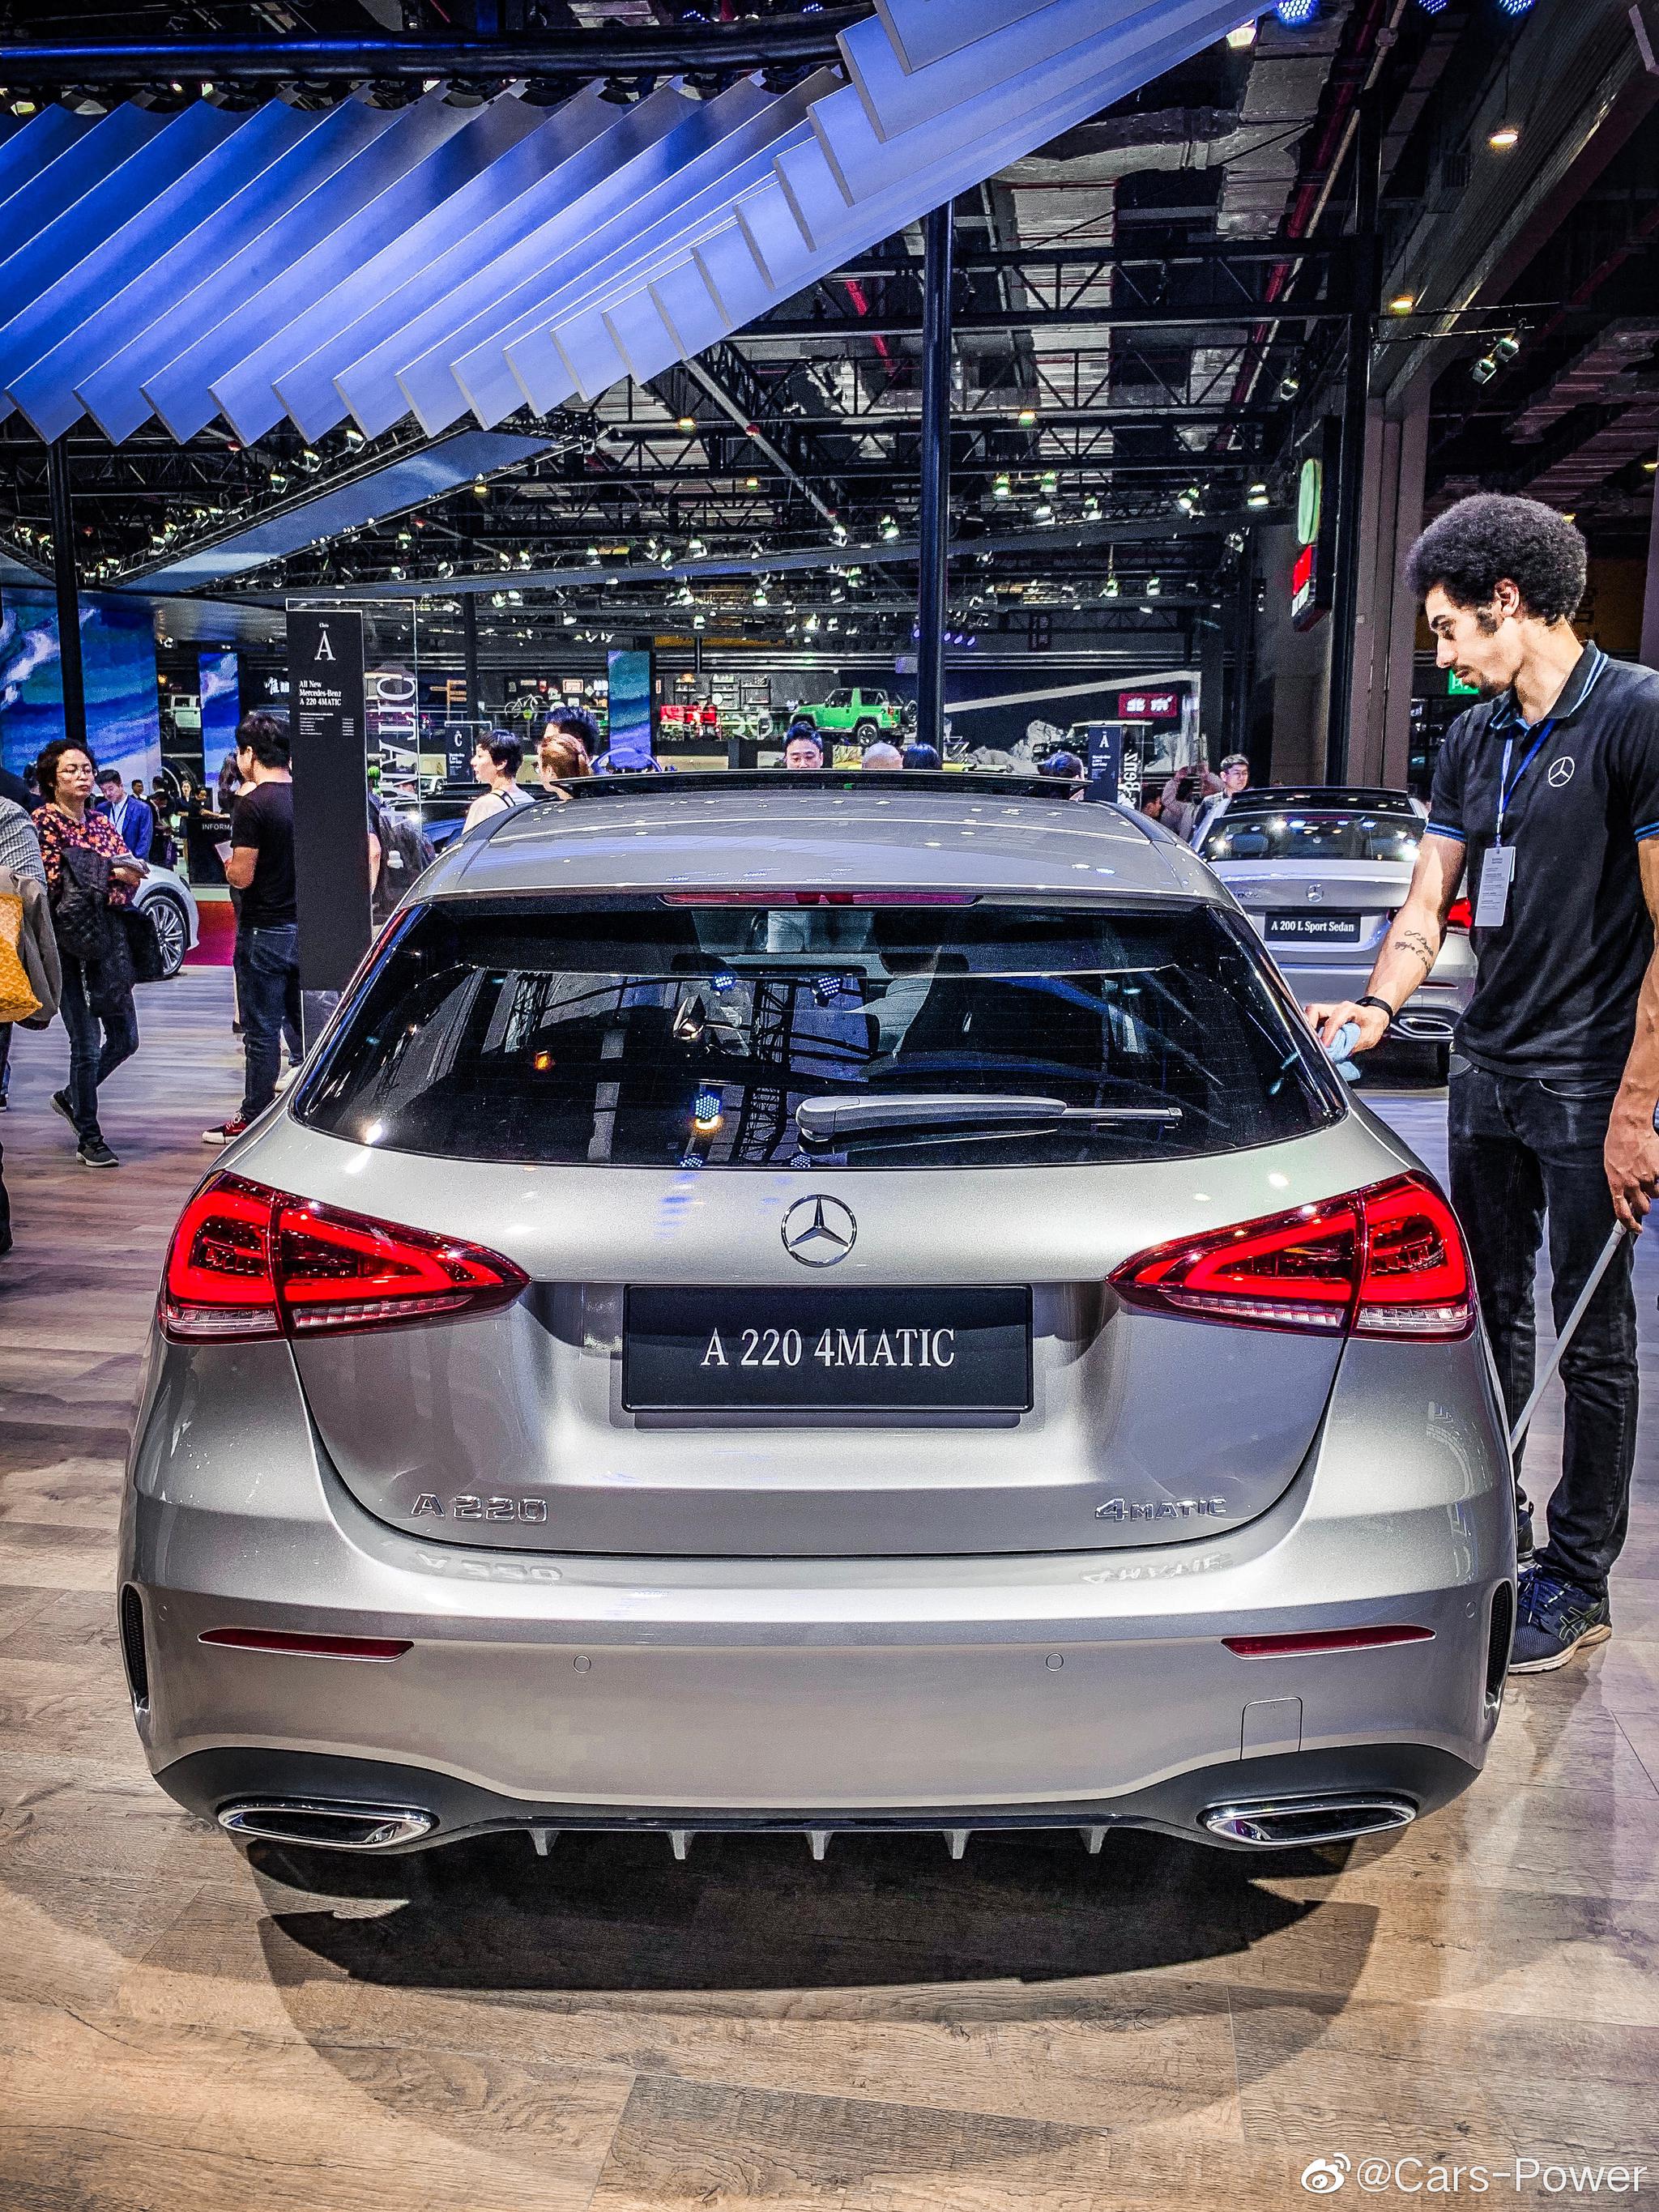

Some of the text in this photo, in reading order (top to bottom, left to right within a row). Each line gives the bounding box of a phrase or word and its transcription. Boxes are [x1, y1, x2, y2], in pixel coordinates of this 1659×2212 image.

[314, 630, 336, 661] A
[299, 680, 308, 688] All
[309, 680, 322, 688] New
[299, 688, 342, 697] Mercedes-Benz
[318, 698, 342, 706] 4MATIC
[1099, 734, 1110, 748] A
[1271, 921, 1354, 933] A 200 L Sport Sedan
[700, 1328, 955, 1368] A 220 4MATIC
[411, 1493, 548, 1523] A 220
[1095, 1497, 1228, 1522] 4MATIC
